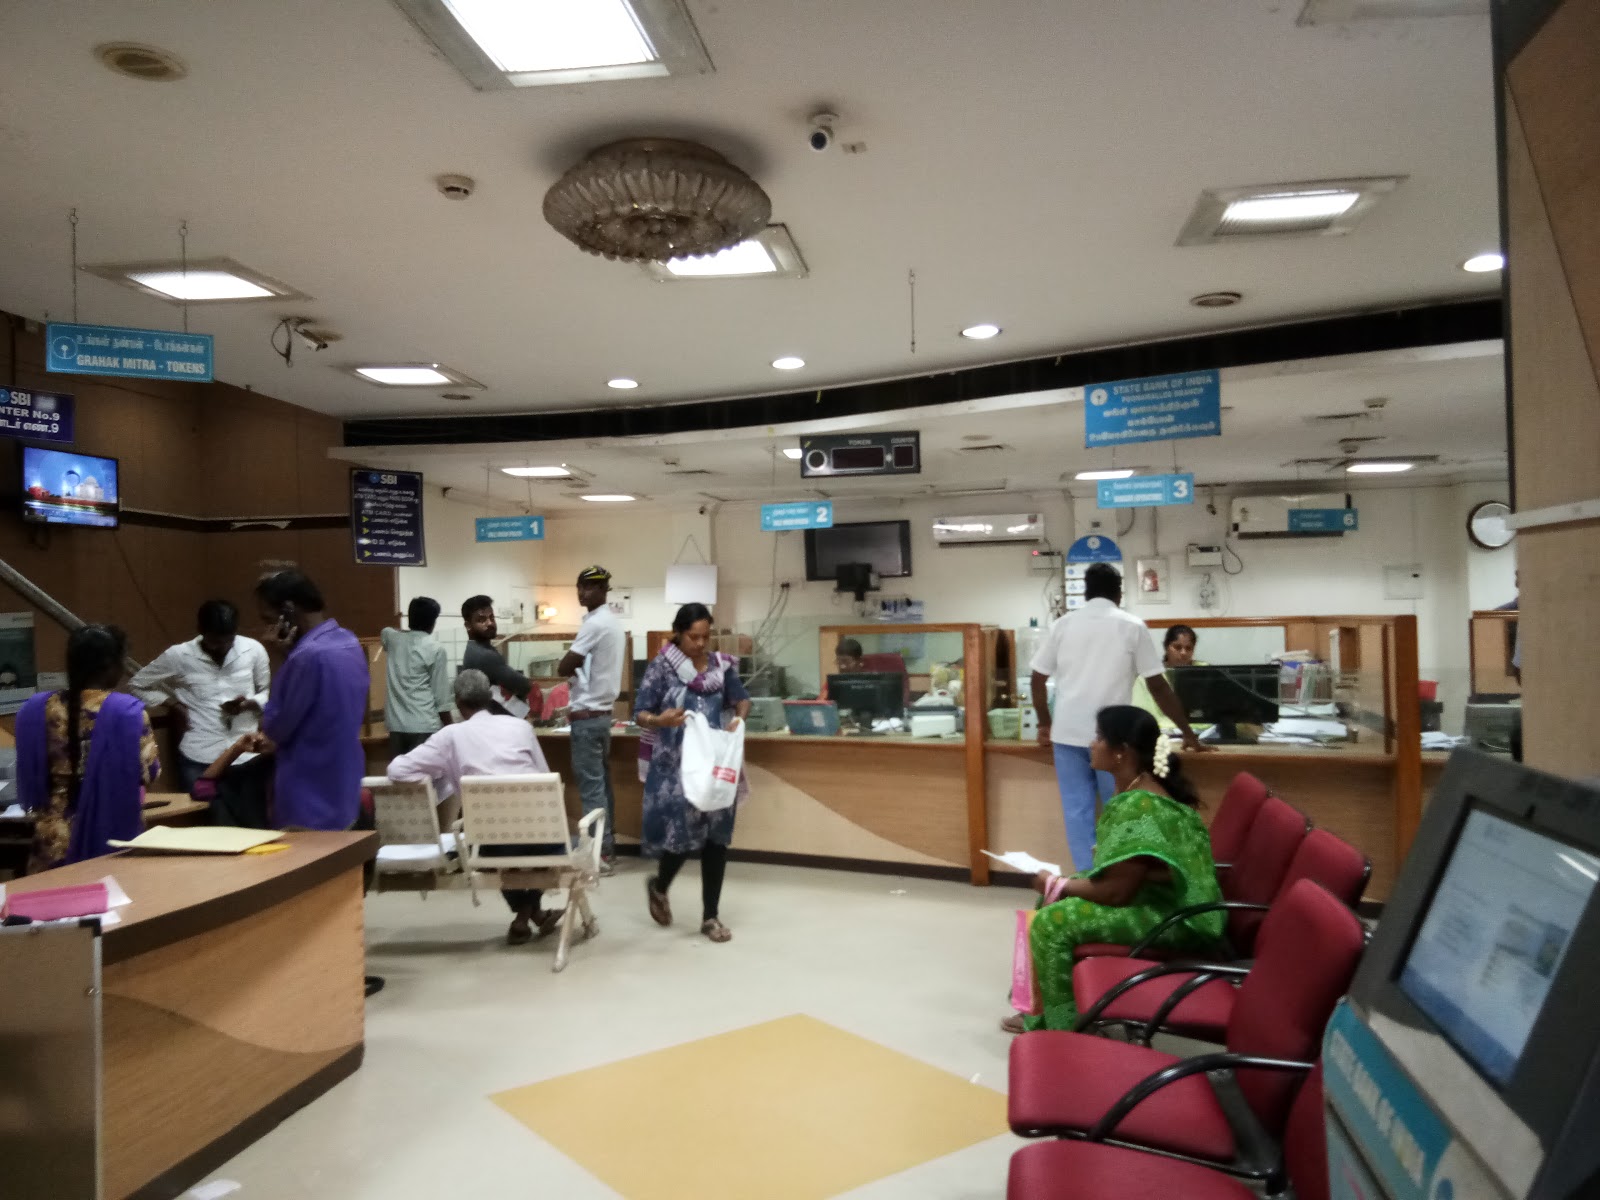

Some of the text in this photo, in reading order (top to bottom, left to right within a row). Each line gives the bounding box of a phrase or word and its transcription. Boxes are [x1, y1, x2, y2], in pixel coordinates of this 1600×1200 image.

[76, 354, 120, 369] GRAHAK
[122, 357, 157, 371] MITRA
[167, 360, 206, 375] TOKENS
[1113, 375, 1213, 396] STATE BANK OF INDIA
[10, 391, 31, 406] SBI
[32, 410, 60, 421] No.9
[381, 474, 398, 485] SBI
[1172, 479, 1188, 498] 3
[816, 506, 828, 523] 2
[529, 520, 539, 535] 1
